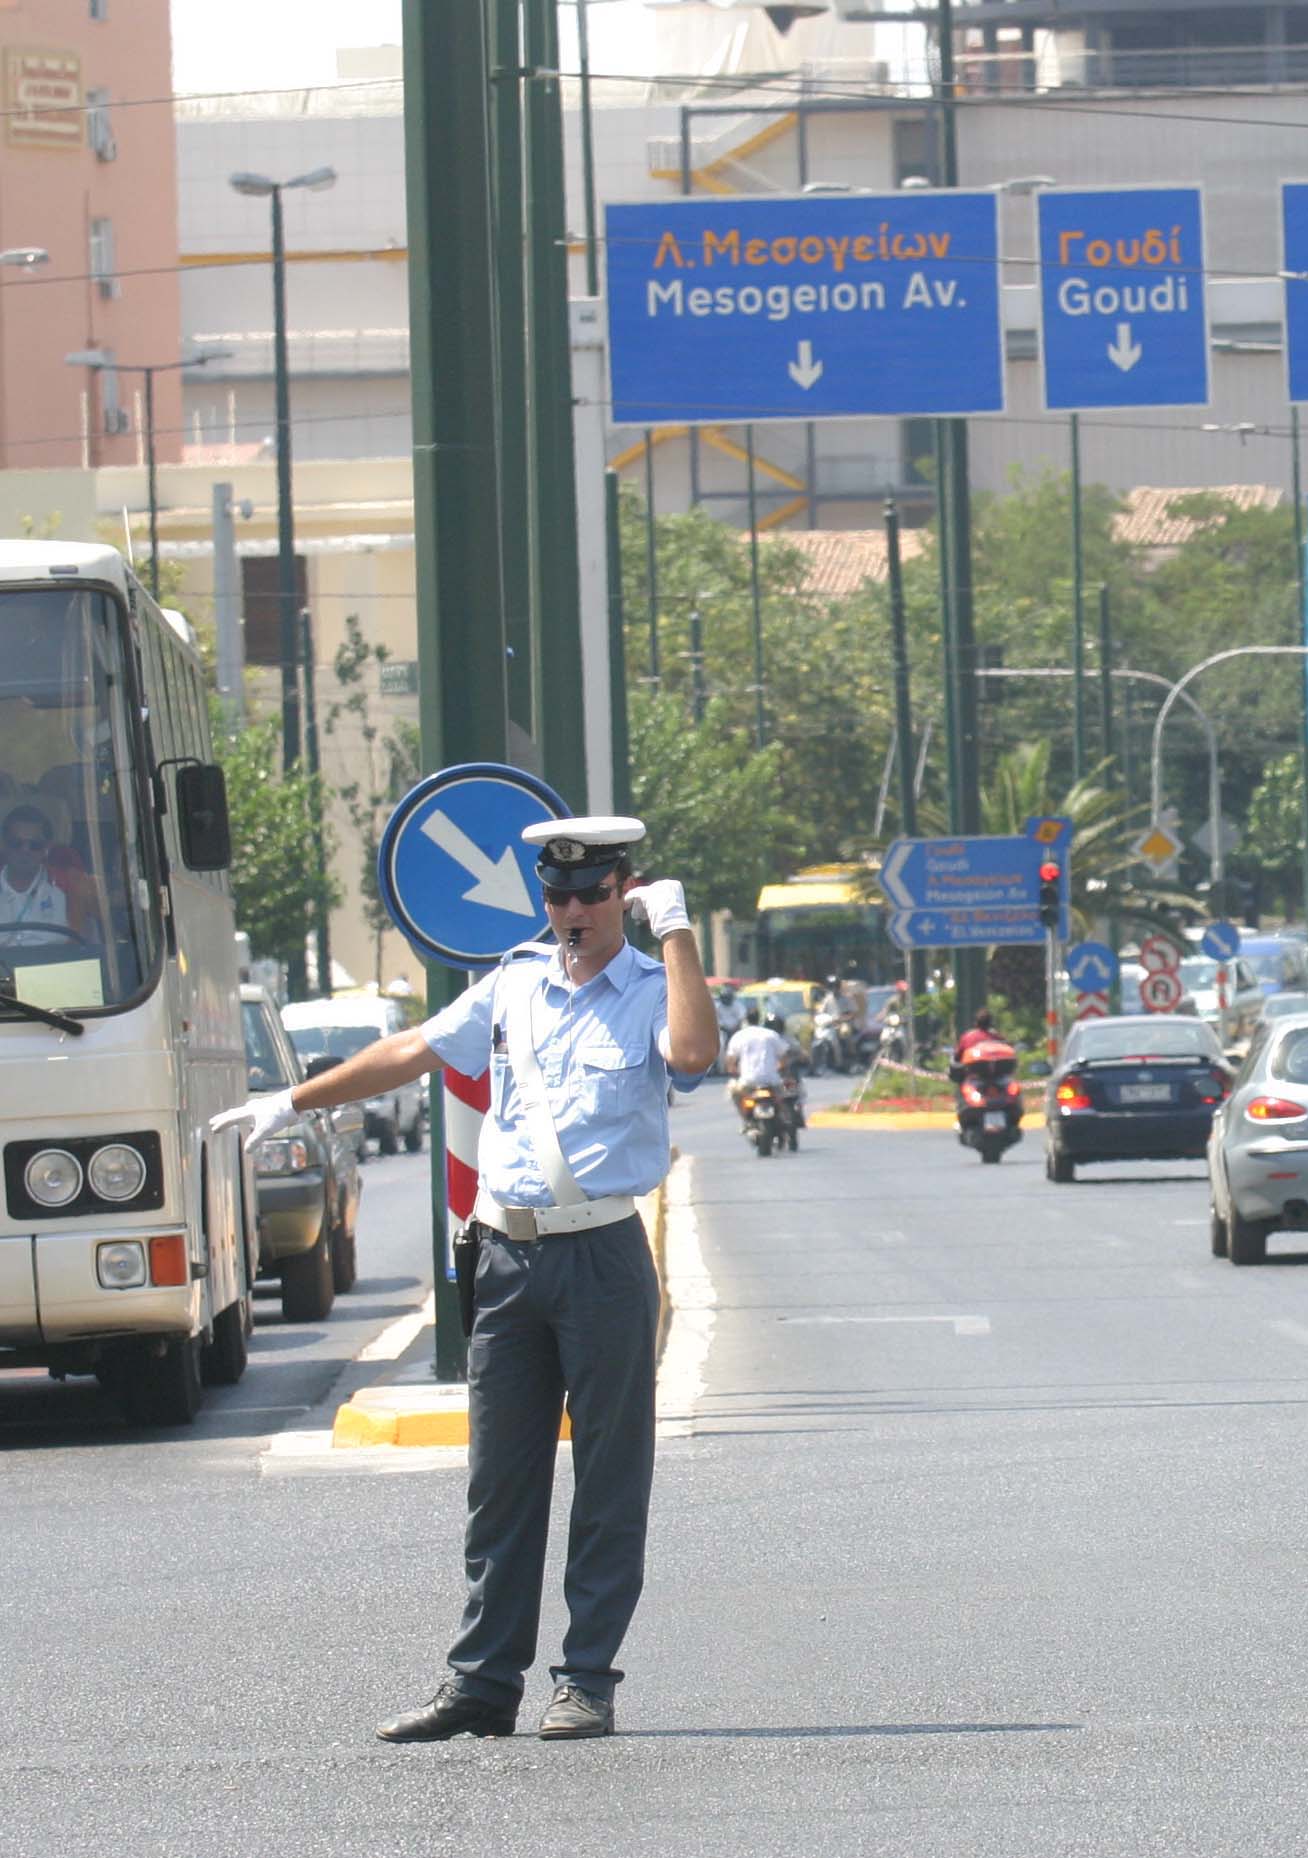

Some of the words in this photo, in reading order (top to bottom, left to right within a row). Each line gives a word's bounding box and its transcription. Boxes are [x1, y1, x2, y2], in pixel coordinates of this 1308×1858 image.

[1058, 225, 1181, 267] Γουδί
[648, 279, 885, 320] Mesogeion
[903, 272, 967, 309] Av.
[1058, 277, 1188, 316] Goudi
